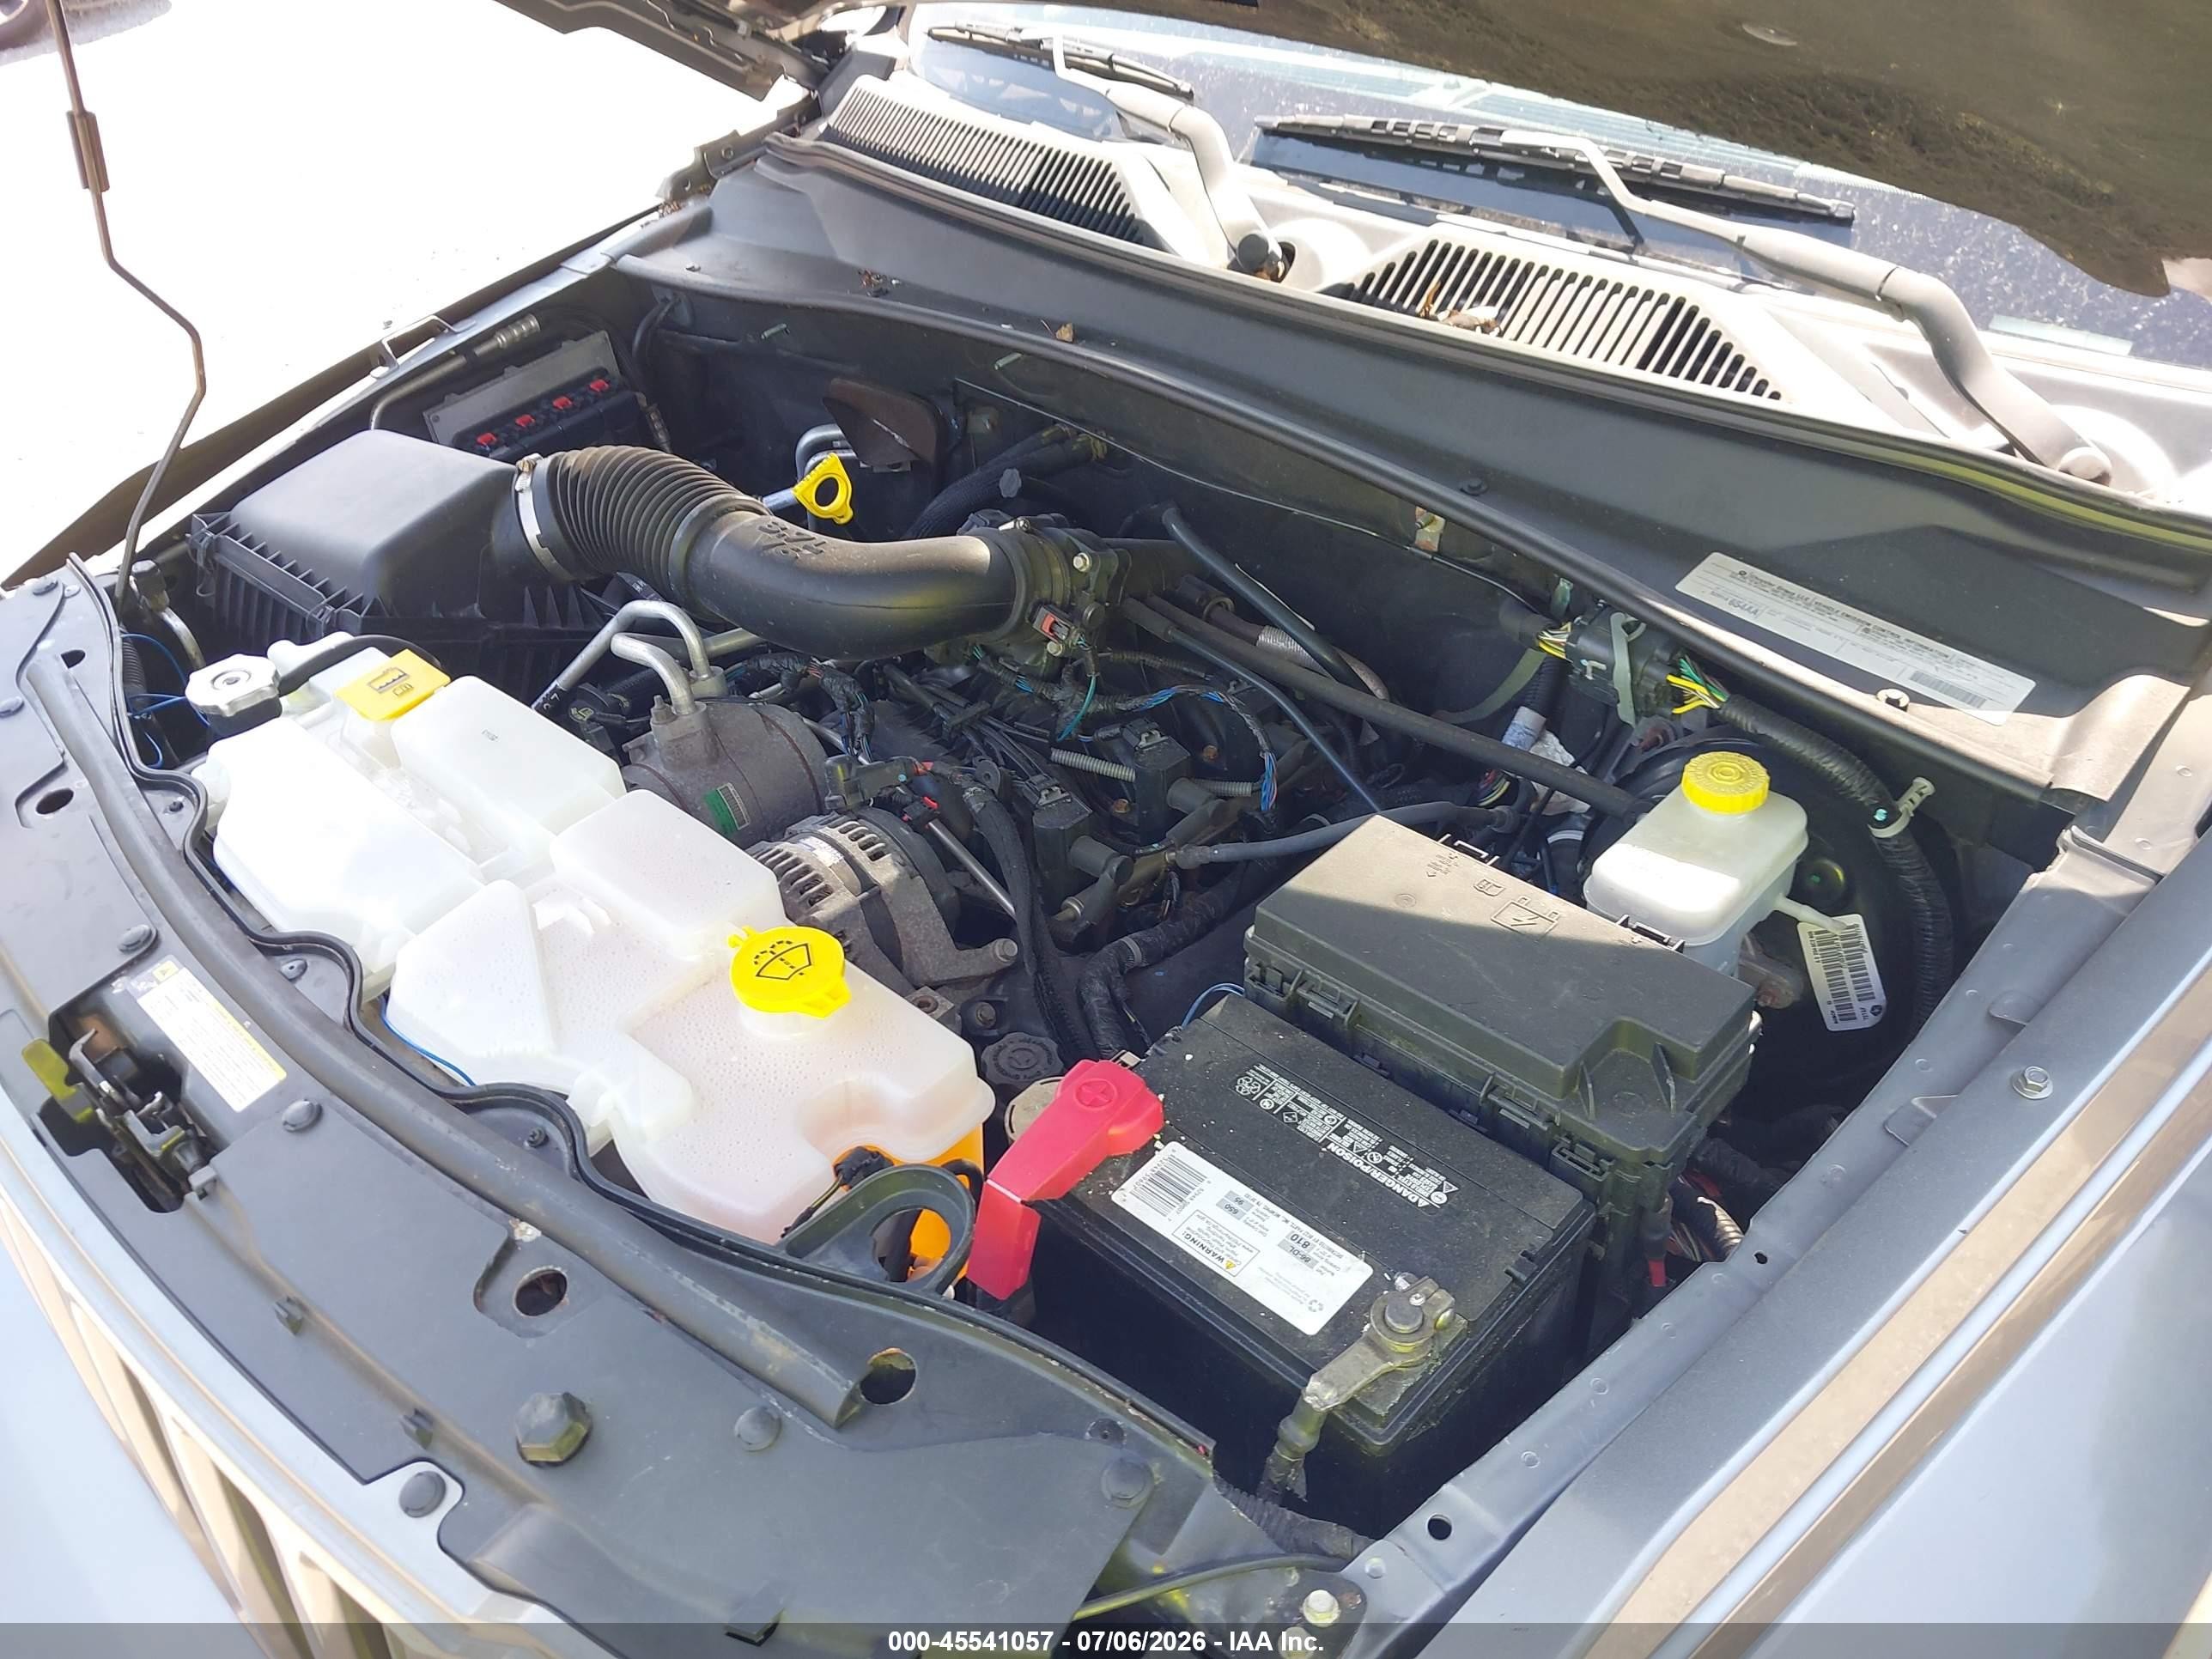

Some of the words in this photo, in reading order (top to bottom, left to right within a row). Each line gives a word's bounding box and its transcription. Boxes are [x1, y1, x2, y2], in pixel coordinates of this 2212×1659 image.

[1325, 1141, 1420, 1204] DANGER/POISON
[1223, 1202, 1239, 1215] 650
[1232, 1196, 1245, 1206] 95
[1180, 1231, 1226, 1263] WARNING:
[1288, 1231, 1311, 1249] 810
[1285, 1244, 1312, 1263] 86-DL
